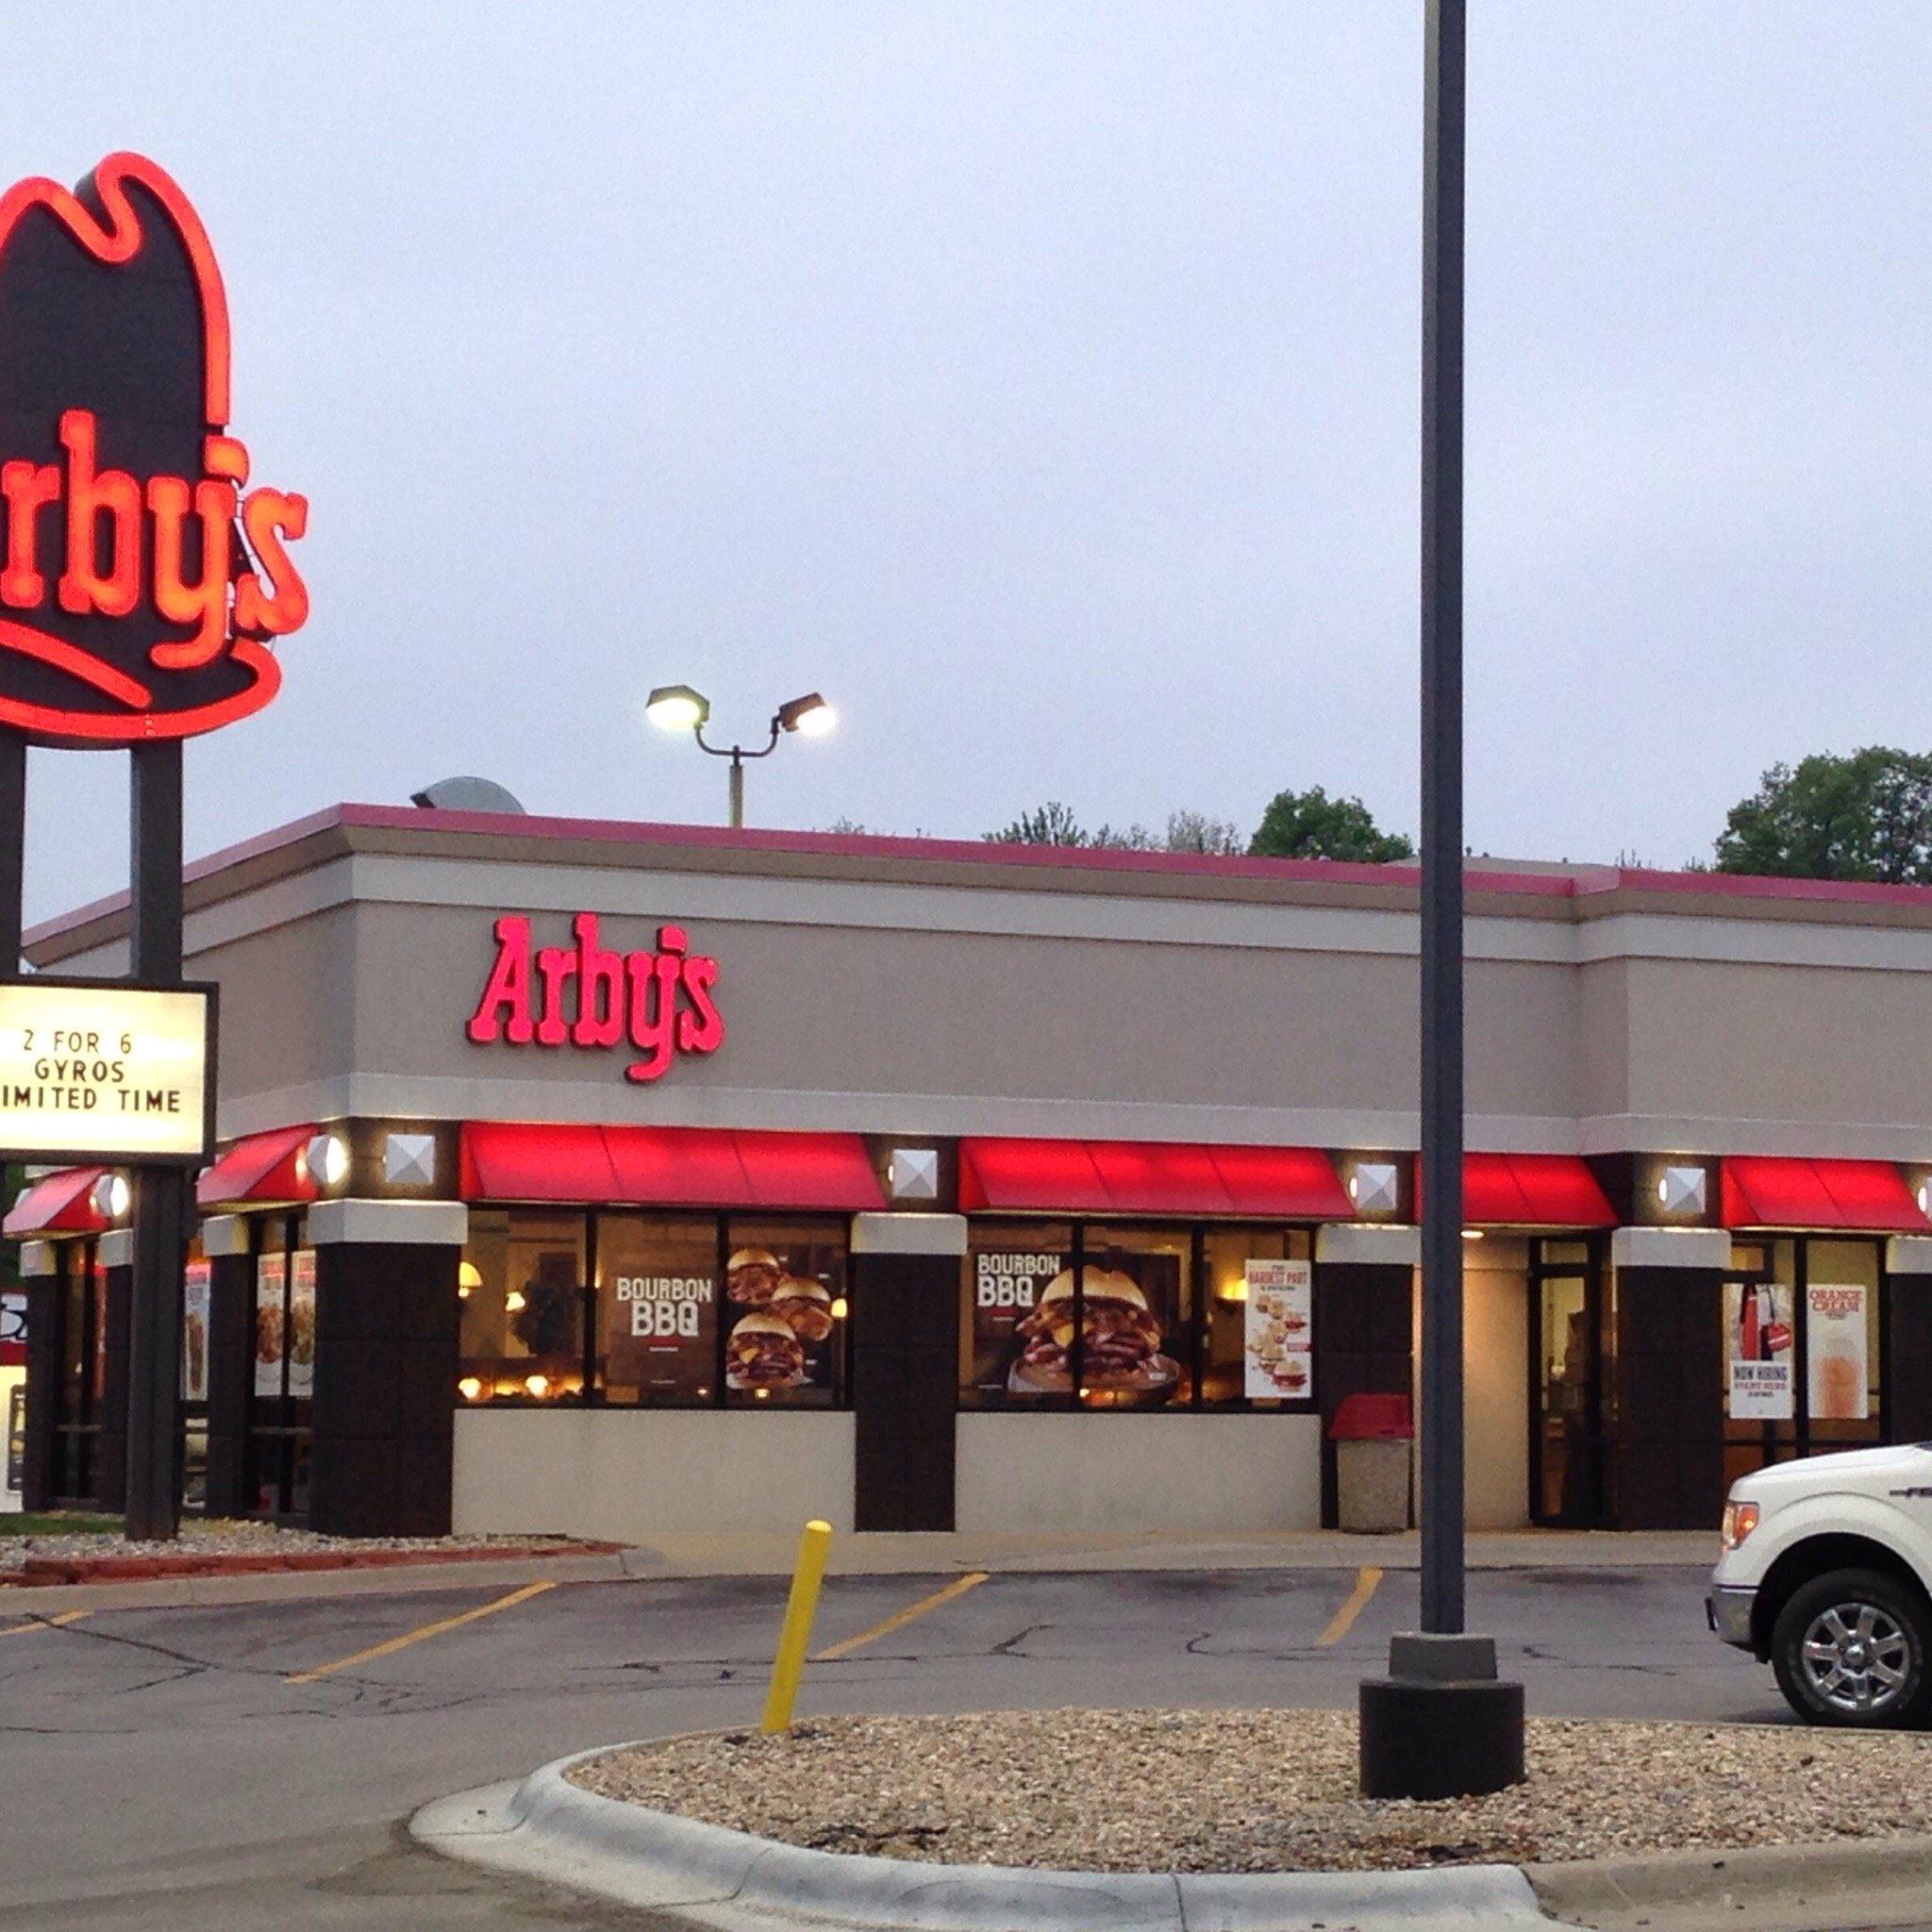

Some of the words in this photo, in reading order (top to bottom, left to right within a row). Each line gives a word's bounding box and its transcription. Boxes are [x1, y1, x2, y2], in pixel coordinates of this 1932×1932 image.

[0, 408, 308, 669] rby's
[467, 910, 724, 1085] Arby's
[24, 1029, 34, 1051] 2
[54, 1031, 99, 1054] FOR
[120, 1034, 131, 1055] 6
[35, 1058, 125, 1083] GYROS
[2, 1086, 97, 1109] IMITED
[118, 1090, 181, 1113] TIME
[977, 1254, 1060, 1275] BOURBON
[617, 1277, 711, 1302] BOURBON
[977, 1275, 1034, 1307] BBQ
[630, 1301, 699, 1337] BBQ
[1734, 1366, 1754, 1380] NOW
[1757, 1366, 1788, 1380] HIRING
